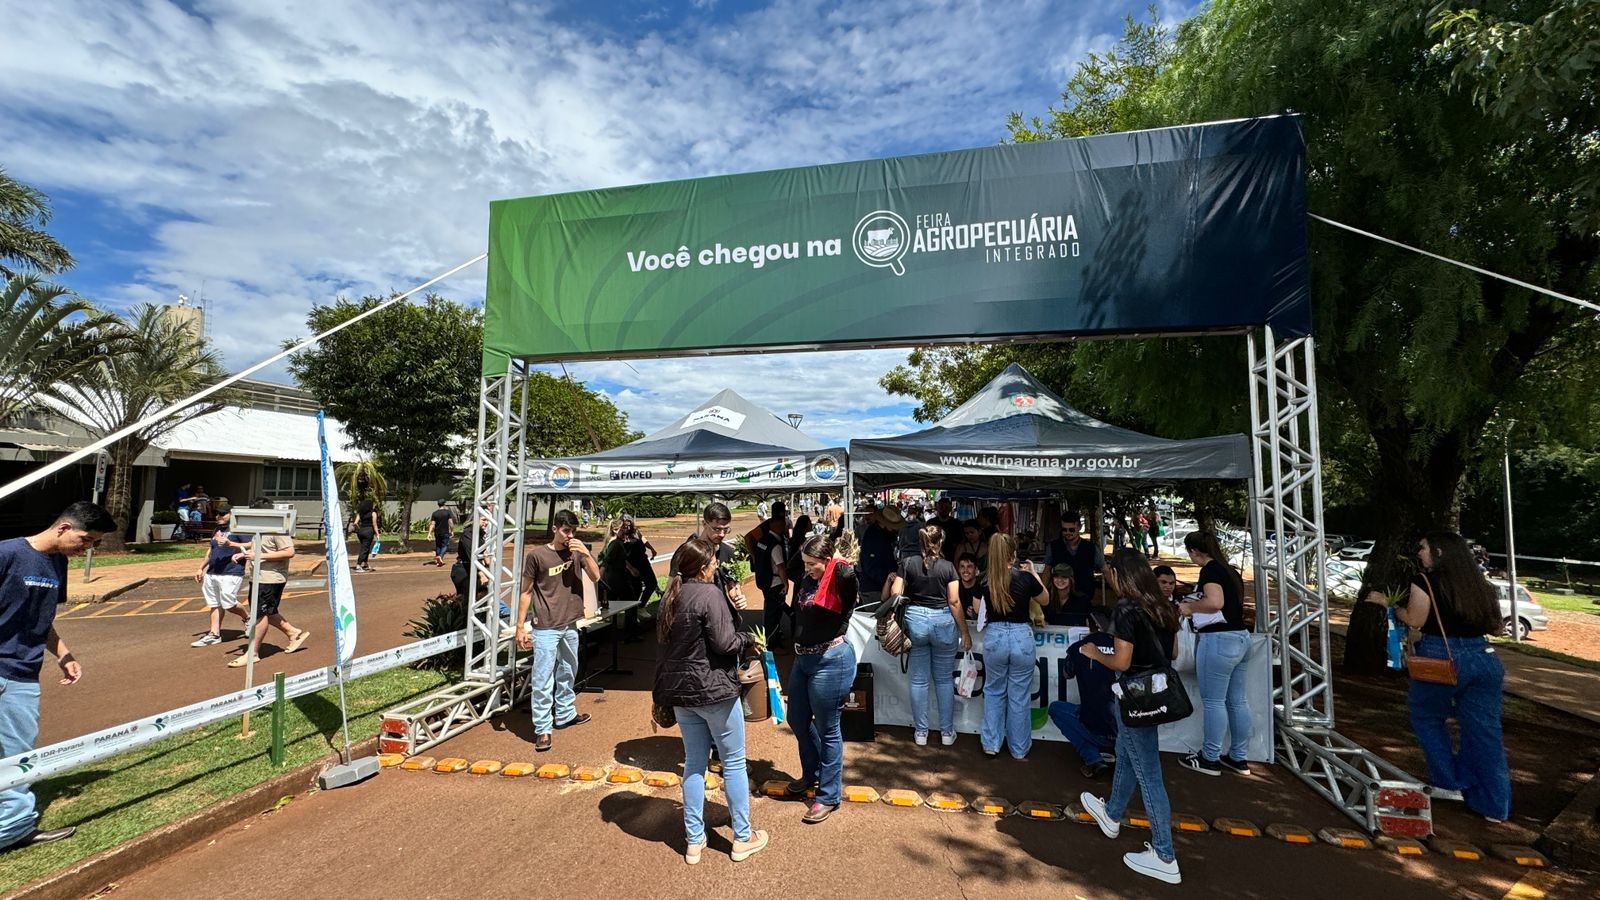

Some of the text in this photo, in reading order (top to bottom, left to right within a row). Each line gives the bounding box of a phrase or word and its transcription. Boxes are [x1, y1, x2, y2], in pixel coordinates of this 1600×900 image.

[916, 212, 951, 229] FEIRA
[913, 213, 1079, 253] AGROPECUÁRIA
[627, 238, 842, 272] Você chegou na
[986, 242, 1080, 263] INTEGRADO
[939, 454, 1141, 471] www.idrparana.pr.gov.br
[621, 470, 652, 480] FAPED
[720, 470, 760, 479] Embrapa
[768, 470, 799, 479] ITAIPU
[40, 741, 85, 759] IDR-Paraná
[94, 727, 130, 744] PARANÁ
